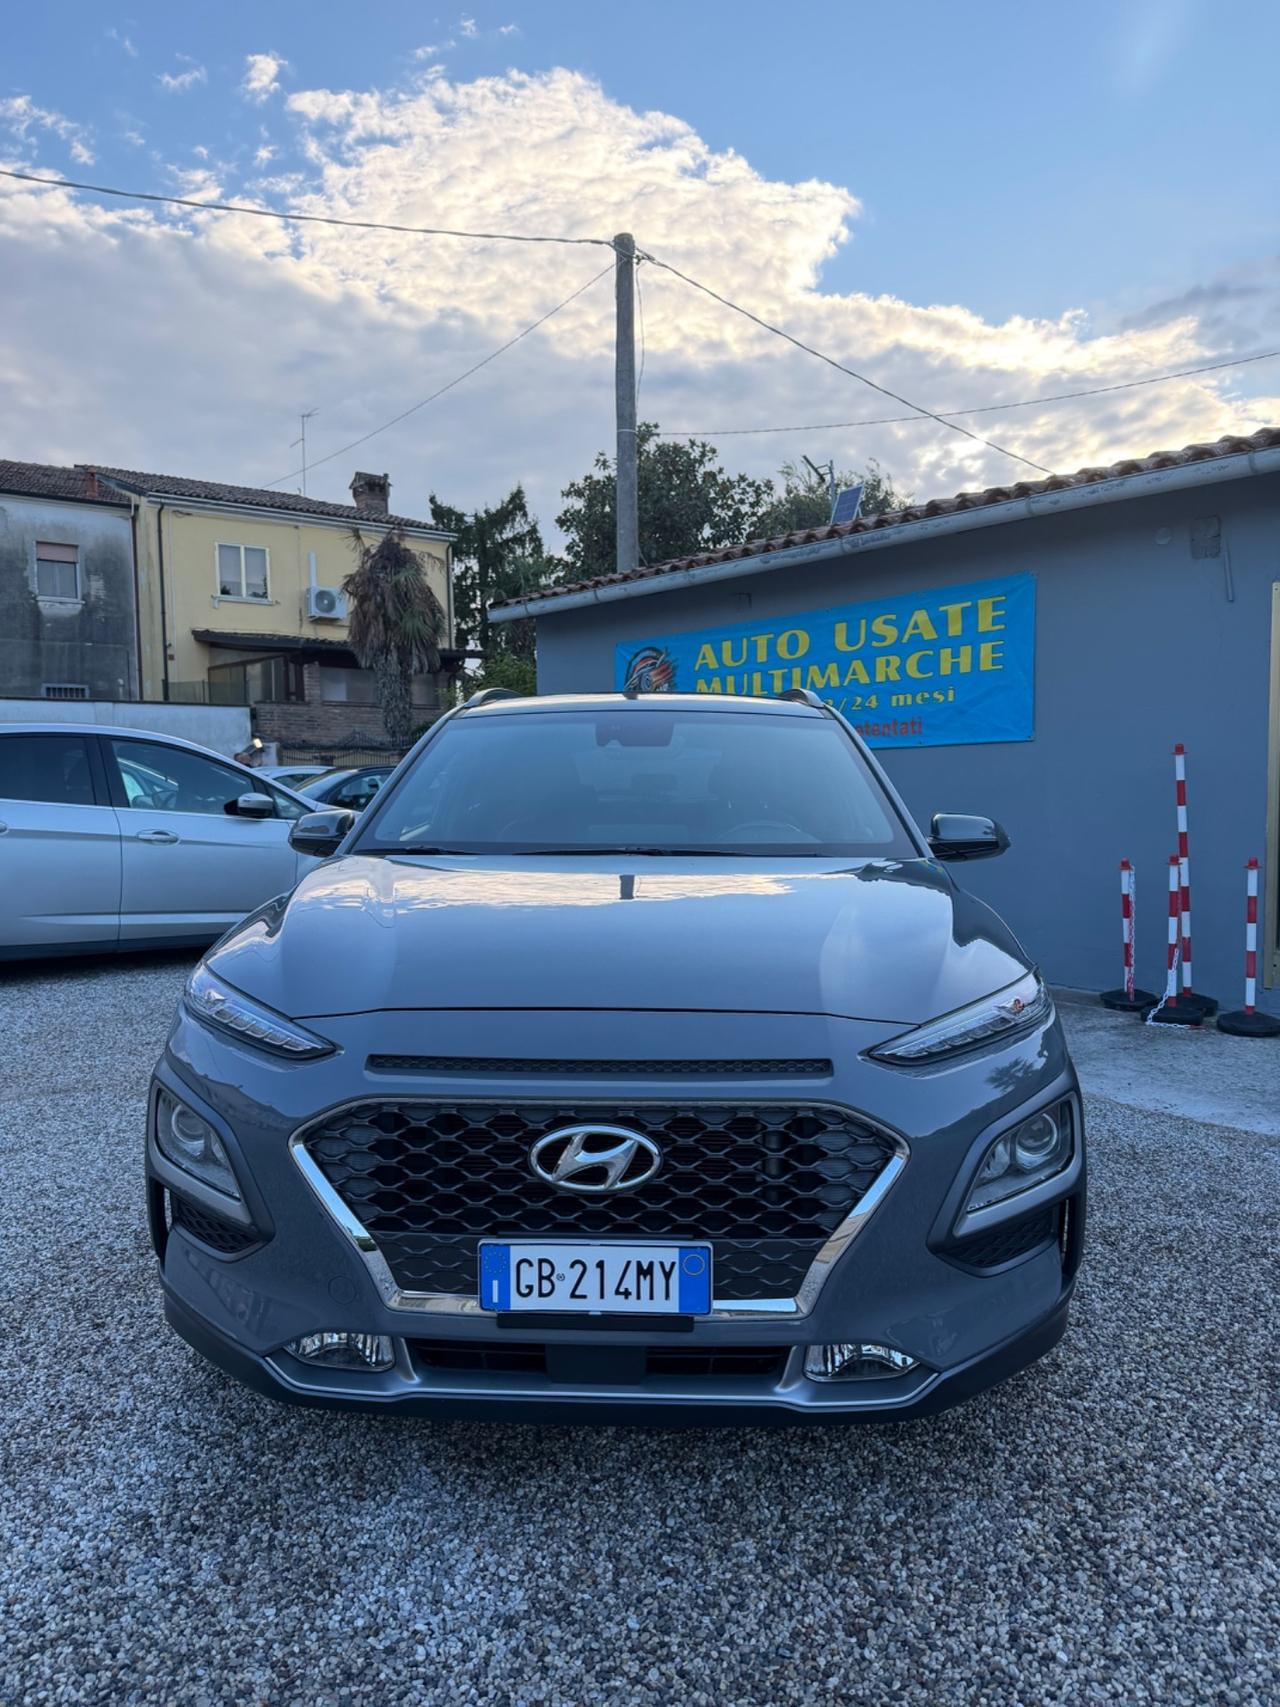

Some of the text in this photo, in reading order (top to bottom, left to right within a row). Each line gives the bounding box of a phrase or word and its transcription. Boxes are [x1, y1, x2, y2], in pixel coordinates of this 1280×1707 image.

[694, 595, 1007, 672] AUTO USATE
[695, 640, 1004, 697] MULTIMARCHE
[891, 686, 955, 707] mesi
